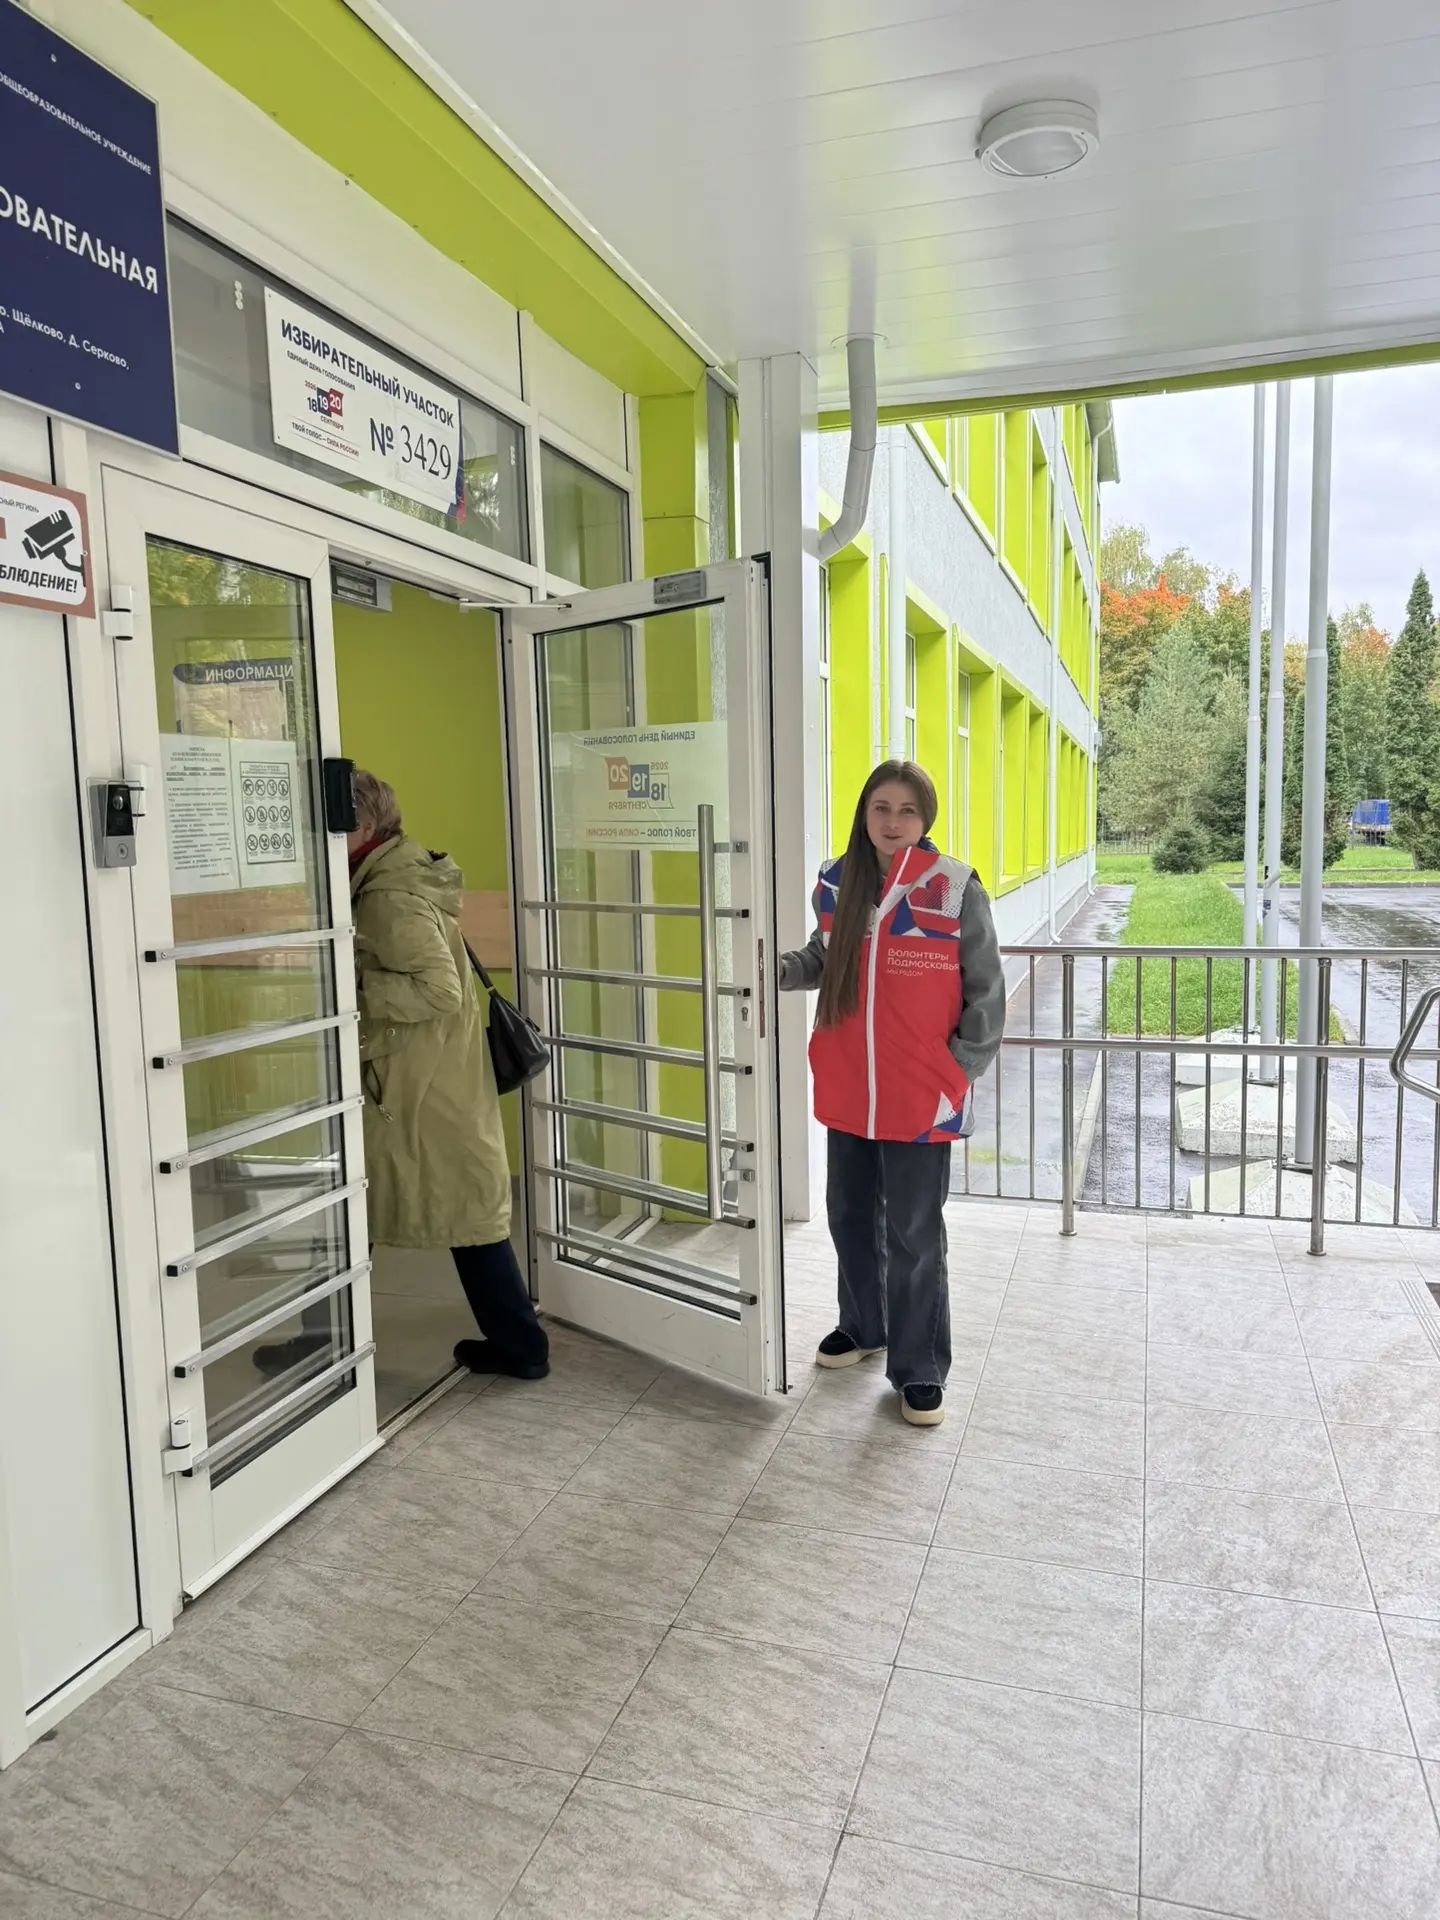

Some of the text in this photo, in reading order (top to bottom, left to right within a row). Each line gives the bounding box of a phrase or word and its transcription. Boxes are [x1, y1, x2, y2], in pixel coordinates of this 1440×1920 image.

[102, 137, 152, 175] УЧРЕЖДЕНИЕ
[12, 308, 67, 343] Щёлково,
[82, 340, 130, 370] Серково,
[281, 318, 454, 428] ИЗБИРАТЕЛЬНЫЙ УЧАСТОК
[322, 368, 356, 391] ГОЛОСОВАНИЯ
[307, 394, 341, 413] 18 19 20
[292, 422, 305, 434] ТВОЙ
[370, 417, 451, 480] № 3429
[0, 564, 78, 593] БЛЮДЕНИЕ!
